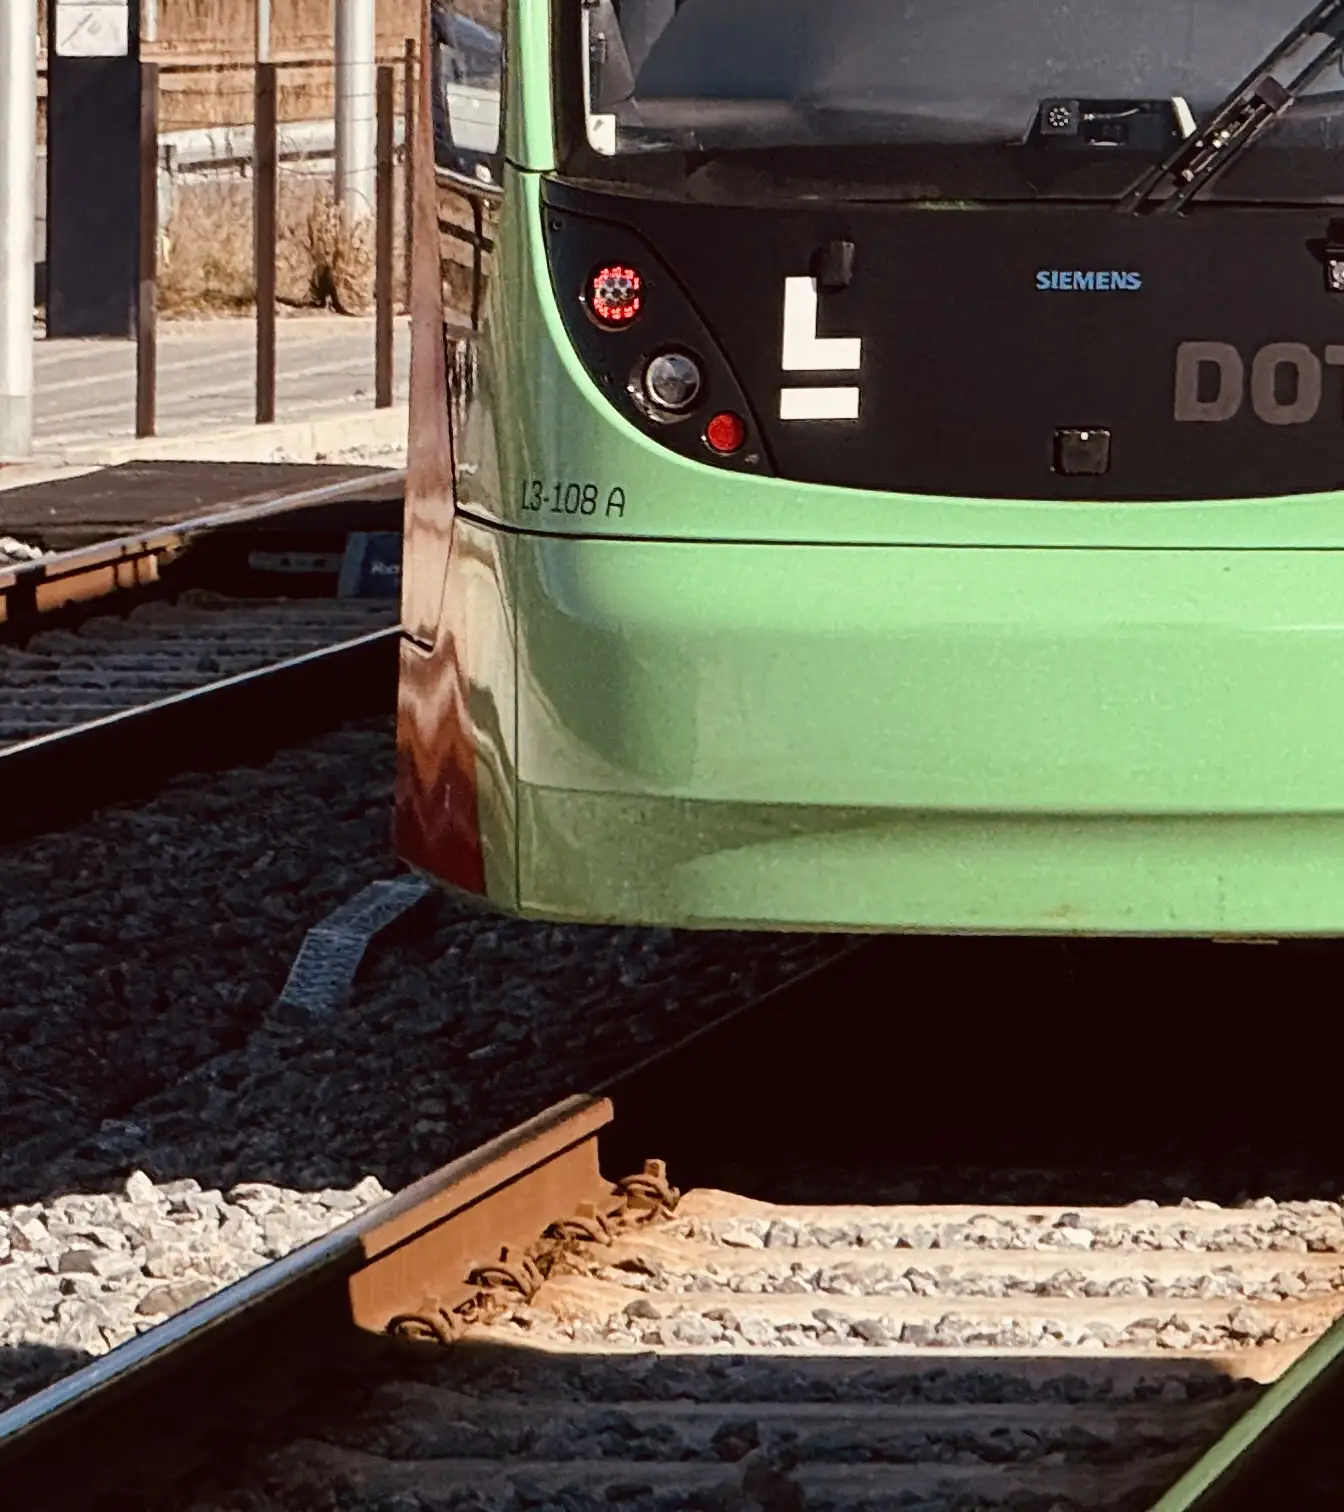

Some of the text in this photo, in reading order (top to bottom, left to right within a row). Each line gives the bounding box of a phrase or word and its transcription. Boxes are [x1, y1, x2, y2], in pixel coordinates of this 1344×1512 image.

[1035, 270, 1142, 290] SIEMENS
[521, 479, 625, 518] L3-108 A
